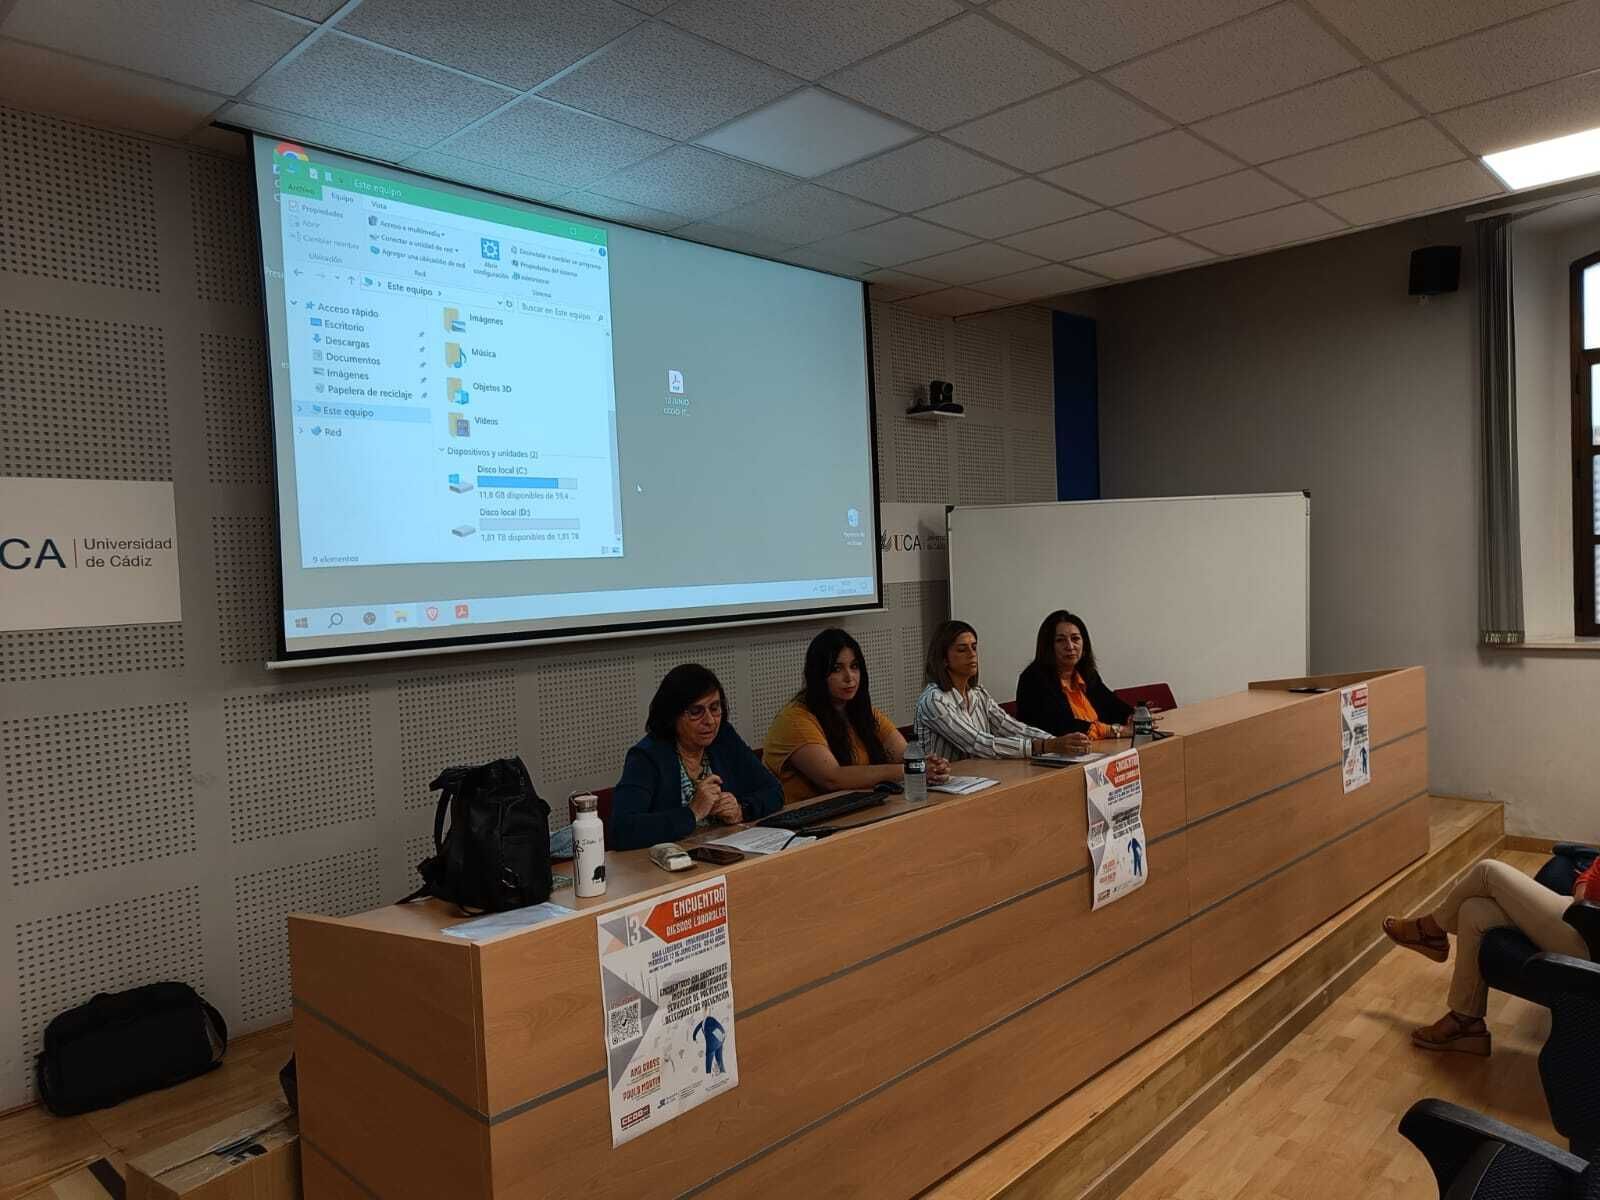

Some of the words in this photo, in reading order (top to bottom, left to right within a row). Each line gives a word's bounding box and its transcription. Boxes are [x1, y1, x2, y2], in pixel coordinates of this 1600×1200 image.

[302, 204, 344, 218] Propiedades
[381, 234, 408, 245] Conectar
[382, 248, 406, 259] Agregar
[388, 282, 404, 292] Este
[406, 284, 433, 297] equipo
[318, 302, 350, 314] Acceso
[352, 305, 379, 318] rápido
[522, 302, 543, 313] Buscar
[570, 312, 591, 321] equipo
[469, 312, 504, 326] Imágenes
[324, 320, 364, 332] Escritorio
[326, 336, 370, 350] Descargas
[326, 352, 381, 366] Documentos
[472, 348, 496, 358] Música
[327, 368, 369, 380] Imágenes
[328, 384, 365, 397] Papelera
[367, 387, 378, 397] de
[380, 389, 412, 400] reciclaje
[472, 382, 500, 393] Objetos
[502, 384, 512, 393] 3D
[324, 406, 342, 416] Este
[344, 408, 374, 418] equipo
[324, 428, 342, 437] Red
[447, 446, 490, 457] Dispositivos
[498, 449, 528, 458] unidades
[530, 450, 538, 459] (2)
[477, 464, 496, 474] Disco
[498, 466, 514, 474] local
[494, 491, 506, 500] GB
[506, 491, 544, 501] disponibles
[480, 508, 499, 516] Disco
[501, 508, 516, 517] local
[508, 533, 544, 542] disponibles
[84, 538, 172, 550] Universidad
[86, 556, 105, 568] de
[110, 555, 152, 568] Cádiz
[320, 555, 359, 563] elementos
[673, 887, 725, 918] ENCUENTRO
[694, 906, 726, 927] LABORALES
[692, 992, 699, 1002] DE
